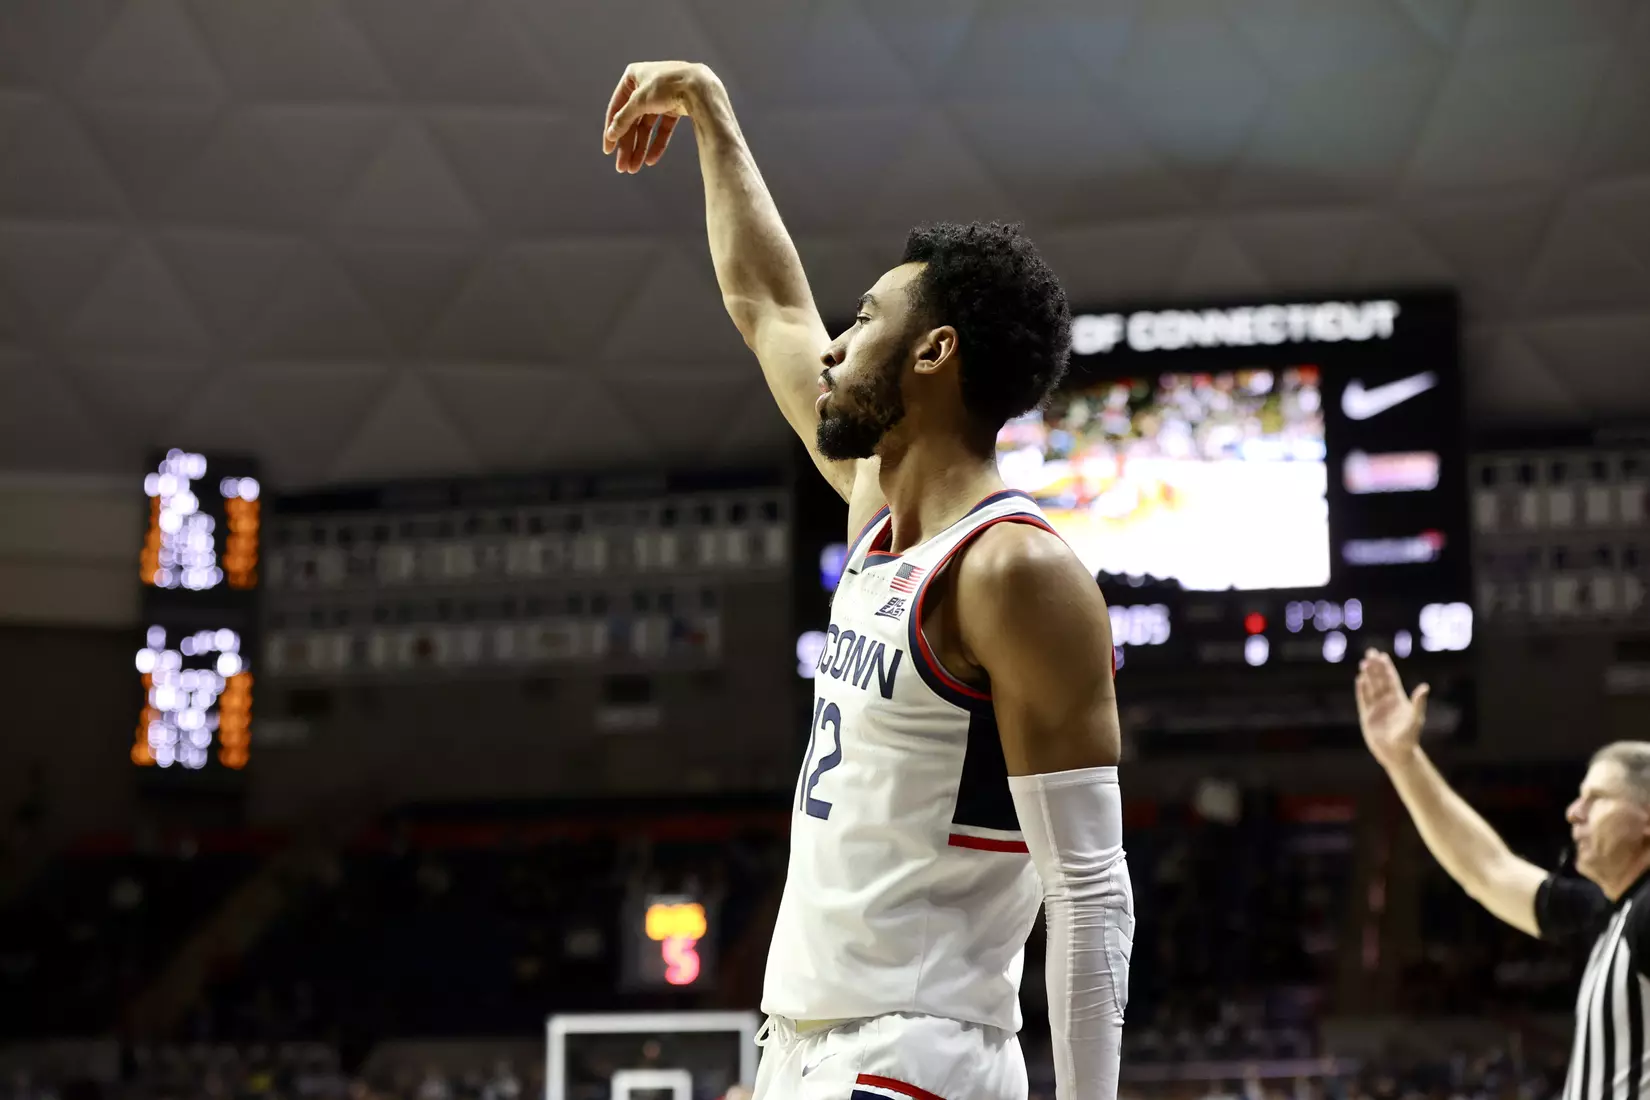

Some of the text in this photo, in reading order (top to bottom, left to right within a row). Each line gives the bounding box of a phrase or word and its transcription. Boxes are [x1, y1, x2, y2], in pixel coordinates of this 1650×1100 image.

[1071, 300, 1399, 354] OF CONNECTICUT
[879, 604, 905, 617] EAST
[887, 596, 907, 608] BIG
[816, 623, 903, 700] CONN
[800, 697, 842, 821] 12
